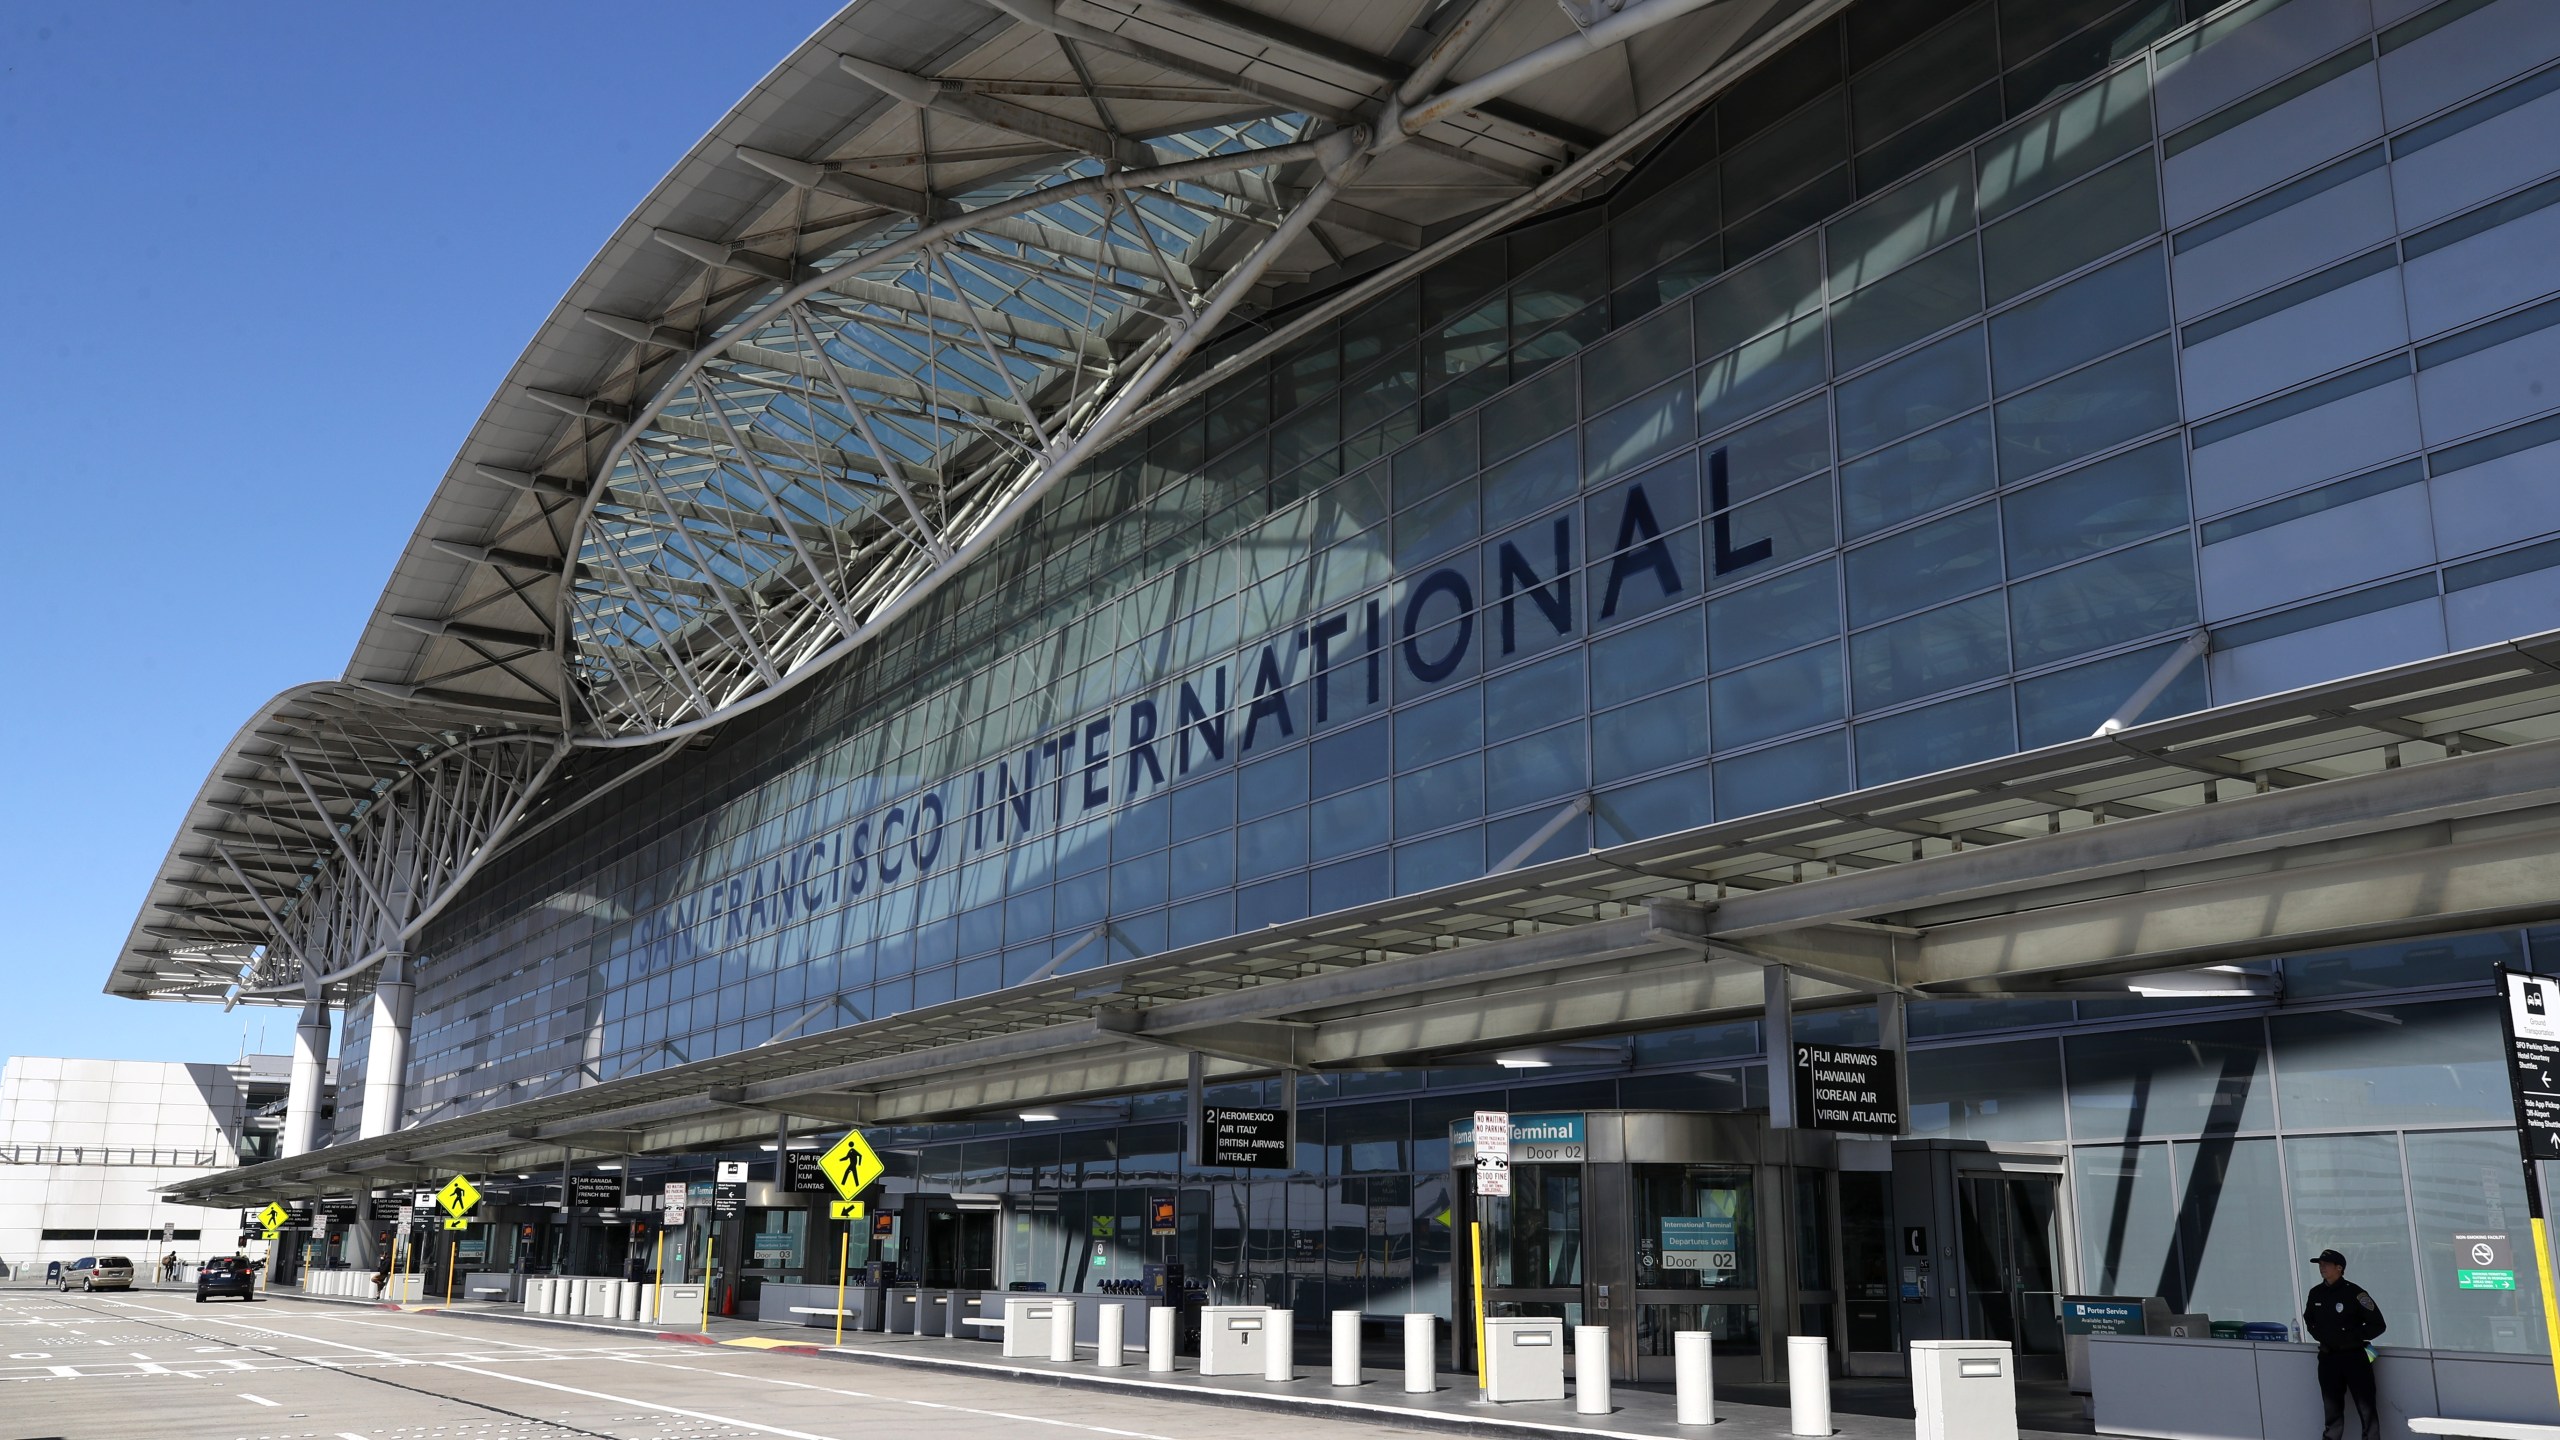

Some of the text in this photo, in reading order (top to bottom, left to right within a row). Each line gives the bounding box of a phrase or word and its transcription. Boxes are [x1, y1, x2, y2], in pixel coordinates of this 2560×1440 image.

[638, 446, 1773, 972] SAN FRANCISCO INTERNATIONAL
[2530, 1017, 2546, 1026] Ground
[2524, 1026, 2554, 1036] Transportation
[2516, 1041, 2559, 1053] SFO Parking Shuttle
[1798, 1048, 1877, 1067] 2 FIJI AIRWAYS
[2517, 1052, 2550, 1063] Hotel Courtesy
[2519, 1061, 2538, 1070] Shuttles
[1815, 1070, 1866, 1084] HAWAIIAN
[1816, 1089, 1877, 1103] KOREAN AIR
[1207, 1110, 1274, 1123] 2 AEROMEXICO
[1477, 1115, 1506, 1124] NO WAITING
[1817, 1109, 1897, 1124] VIRGIN ATLANTIC
[1220, 1125, 1257, 1134] AIR ITALY
[1454, 1122, 1573, 1145] Internat Terminal
[1477, 1125, 1507, 1134] NO PARKING
[1219, 1139, 1284, 1149] BRITISH AIRWAYS
[1219, 1153, 1257, 1161] INTERJET
[1527, 1146, 1581, 1159] Door 02
[789, 1153, 796, 1163] 3
[1706, 1221, 1731, 1229] Terminal
[1669, 1237, 1708, 1246] Departures
[1666, 1254, 1733, 1267] Door 02
[2106, 1307, 2128, 1315] Service
